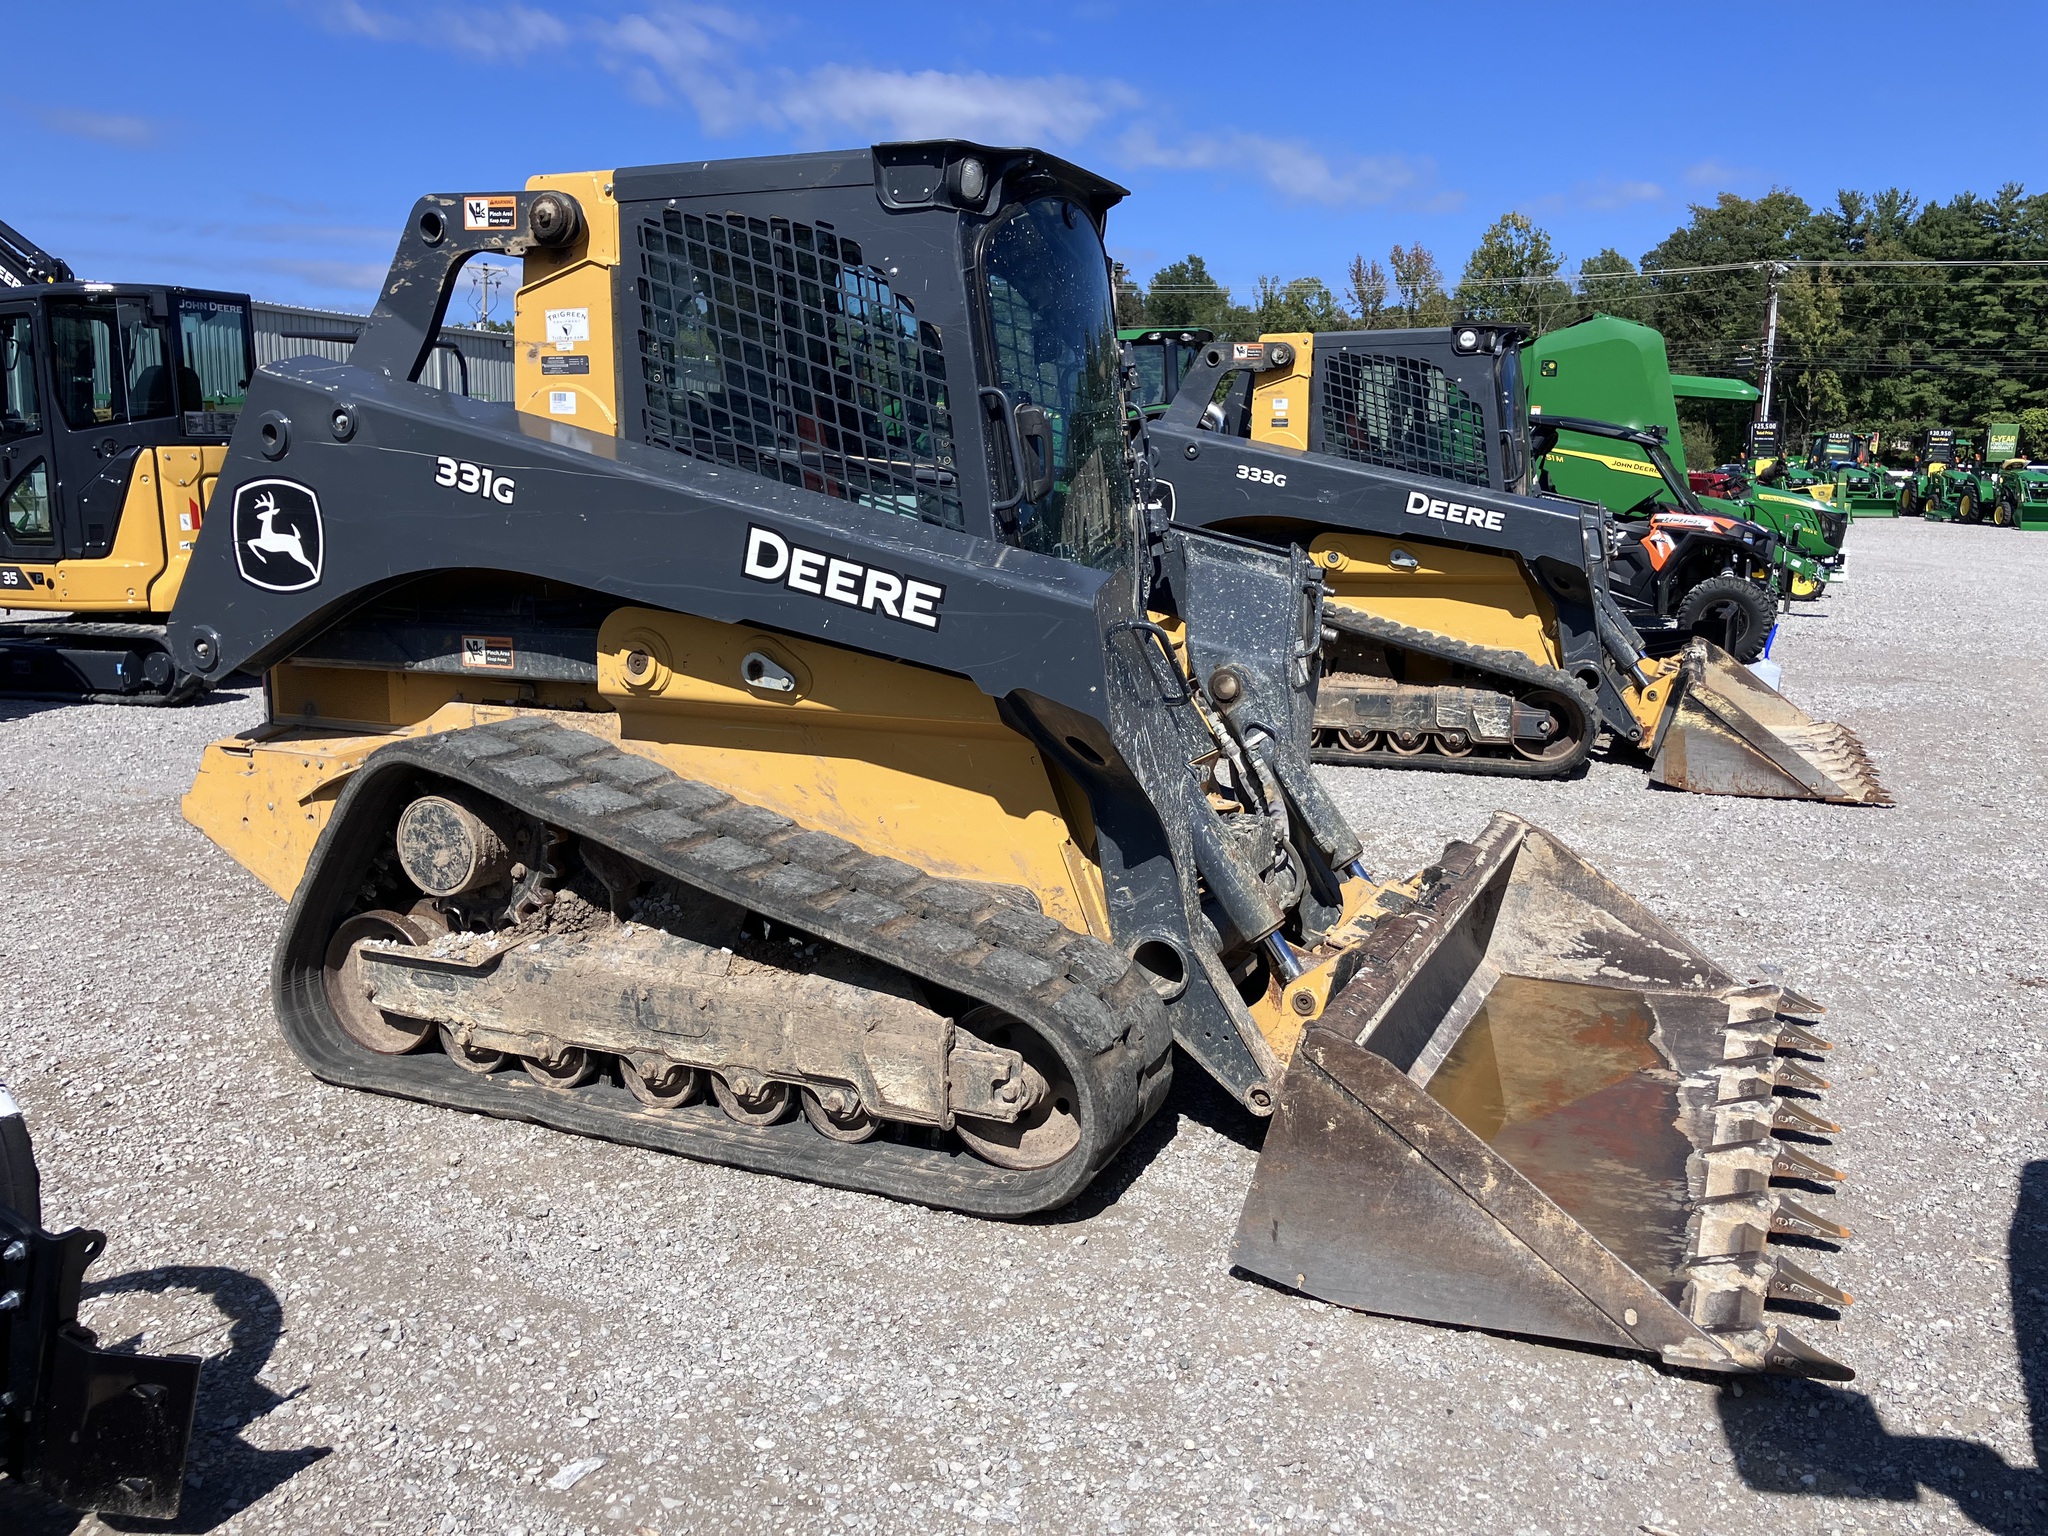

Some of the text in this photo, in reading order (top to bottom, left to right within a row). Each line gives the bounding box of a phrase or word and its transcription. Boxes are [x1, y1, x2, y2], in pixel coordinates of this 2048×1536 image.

[179, 299, 243, 314] JOHN DEERE
[1236, 464, 1287, 488] 333G
[1612, 460, 1632, 468] JOHN
[435, 456, 515, 504] 331G
[1405, 491, 1506, 532] DEERE
[2, 571, 42, 585] 35 P
[744, 527, 943, 628] DEERE
